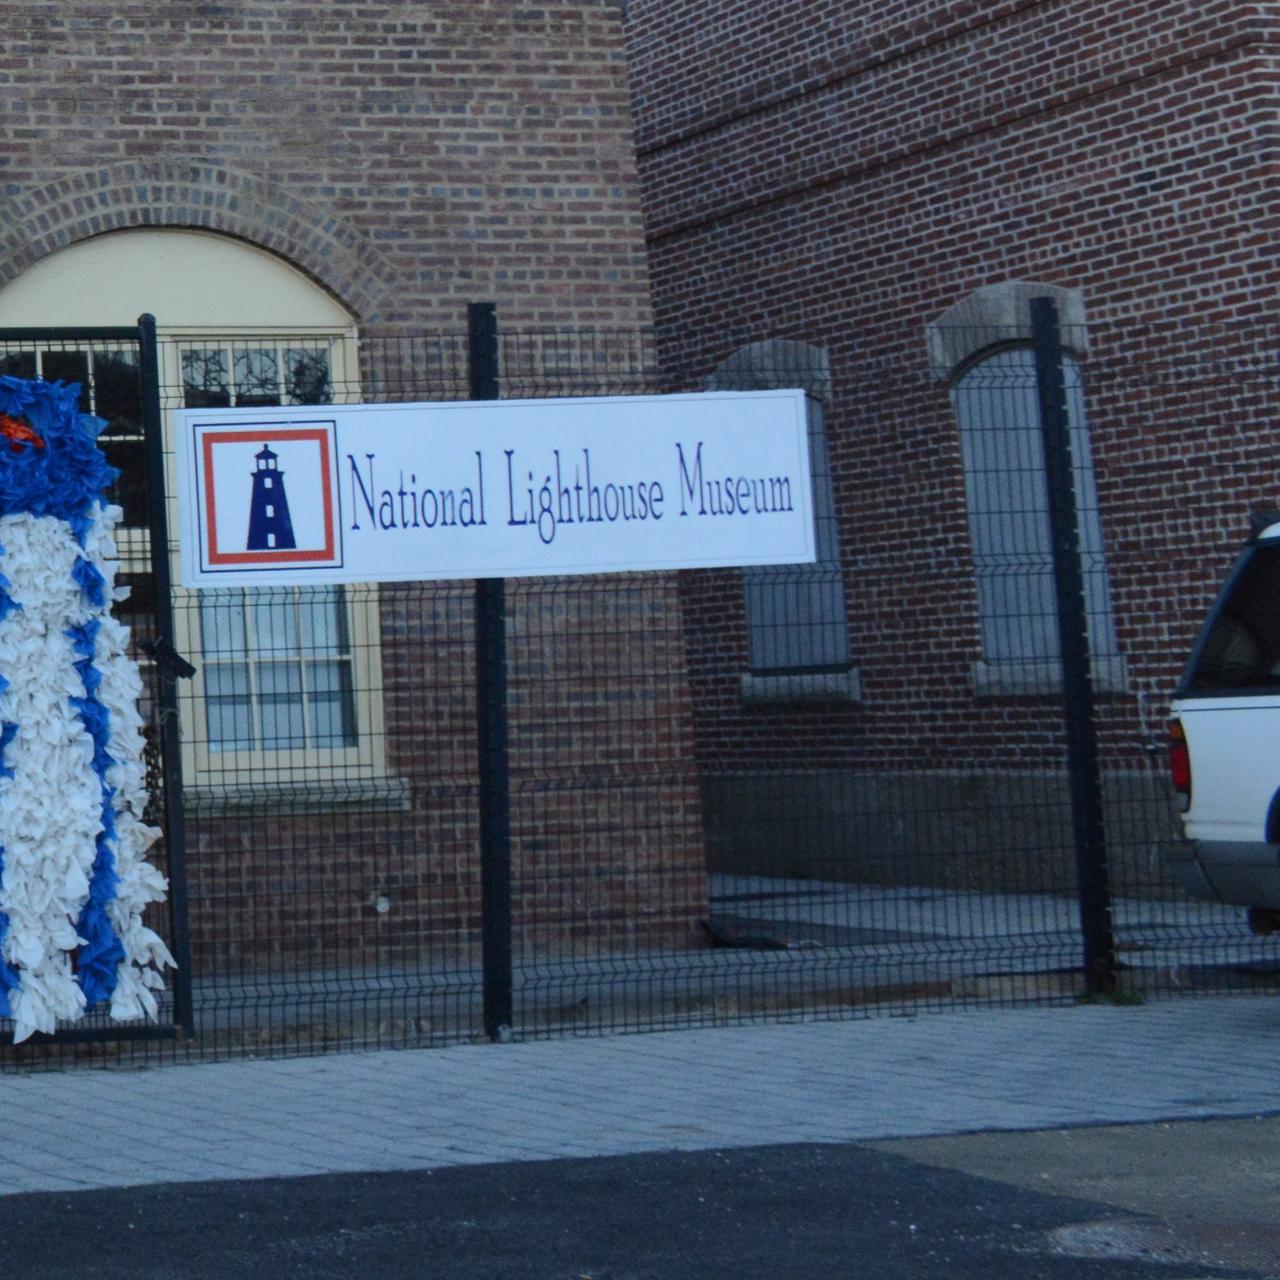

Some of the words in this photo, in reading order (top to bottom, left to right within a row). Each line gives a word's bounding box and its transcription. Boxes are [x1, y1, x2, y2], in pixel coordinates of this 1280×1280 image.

[346, 450, 488, 532] National
[503, 448, 665, 545] Lighthouse
[675, 441, 795, 519] Museum
